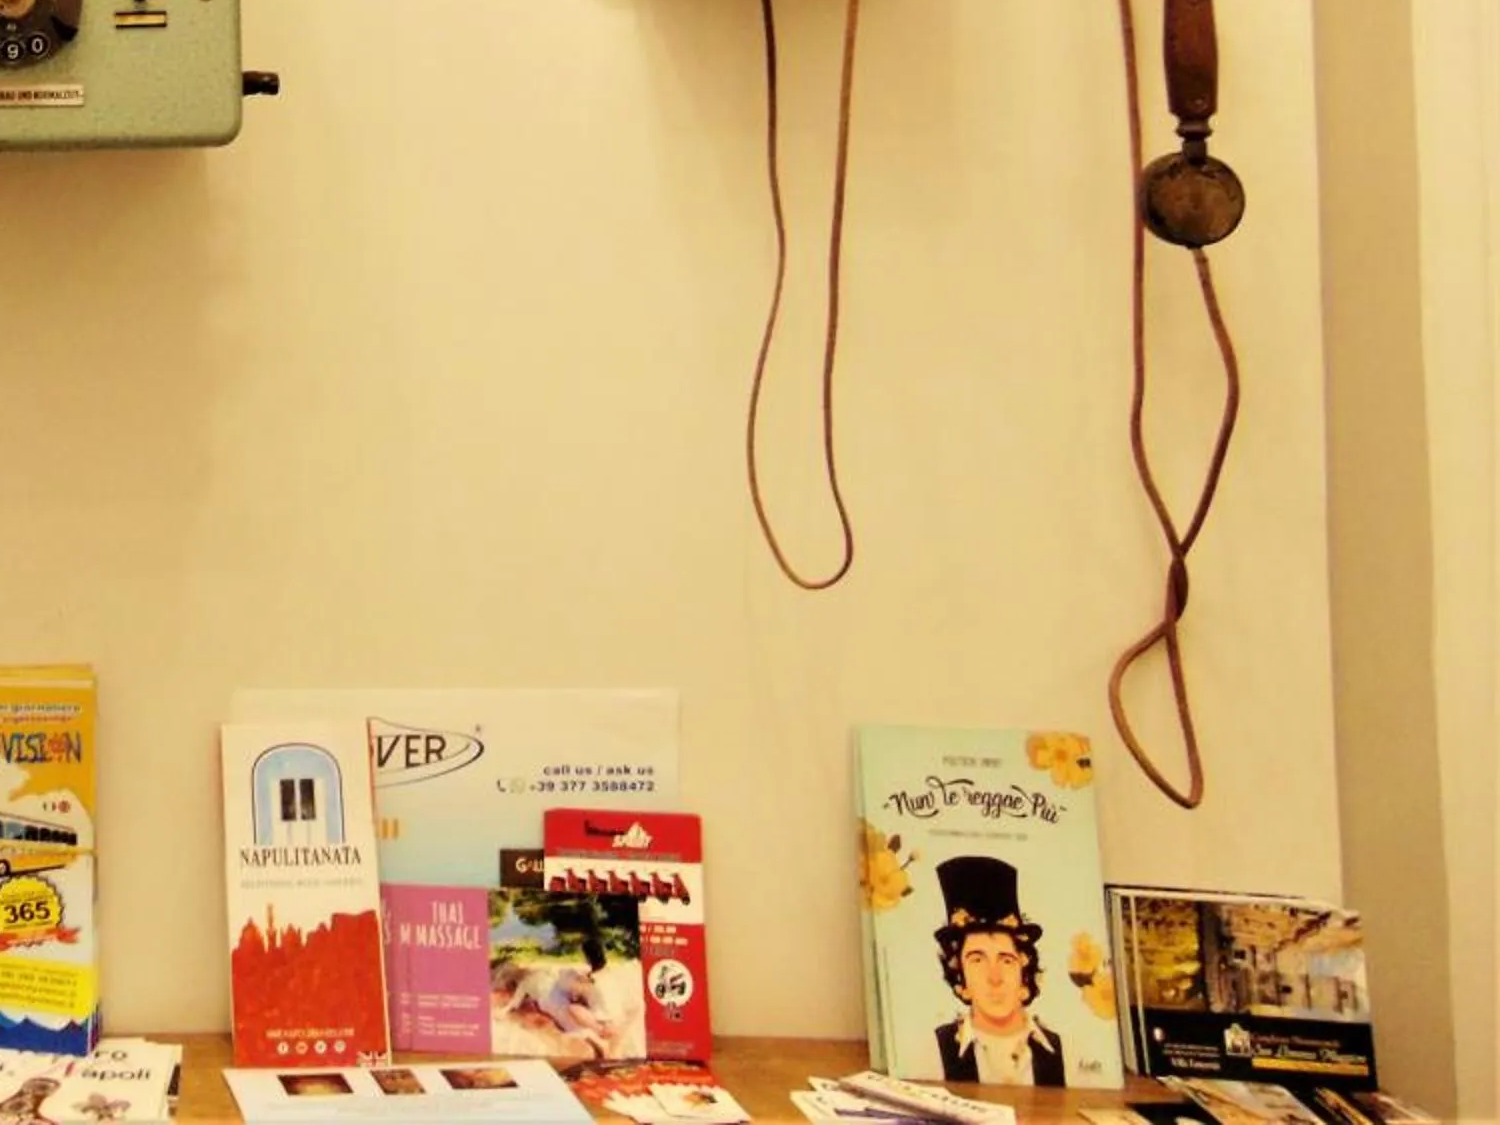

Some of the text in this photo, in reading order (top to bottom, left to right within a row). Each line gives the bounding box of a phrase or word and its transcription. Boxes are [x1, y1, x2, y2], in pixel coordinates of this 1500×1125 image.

[7, 45, 19, 59] 9
[32, 39, 43, 53] 0
[543, 765, 571, 775] call
[575, 766, 592, 775] us
[606, 765, 632, 775] ask
[637, 766, 654, 775] us
[560, 781, 586, 792] 377
[963, 786, 1028, 819] reggae
[240, 847, 362, 867] NAPULITANATA
[4, 901, 51, 924] 365
[431, 901, 464, 925] THAI
[416, 923, 482, 950] MASSAGE
